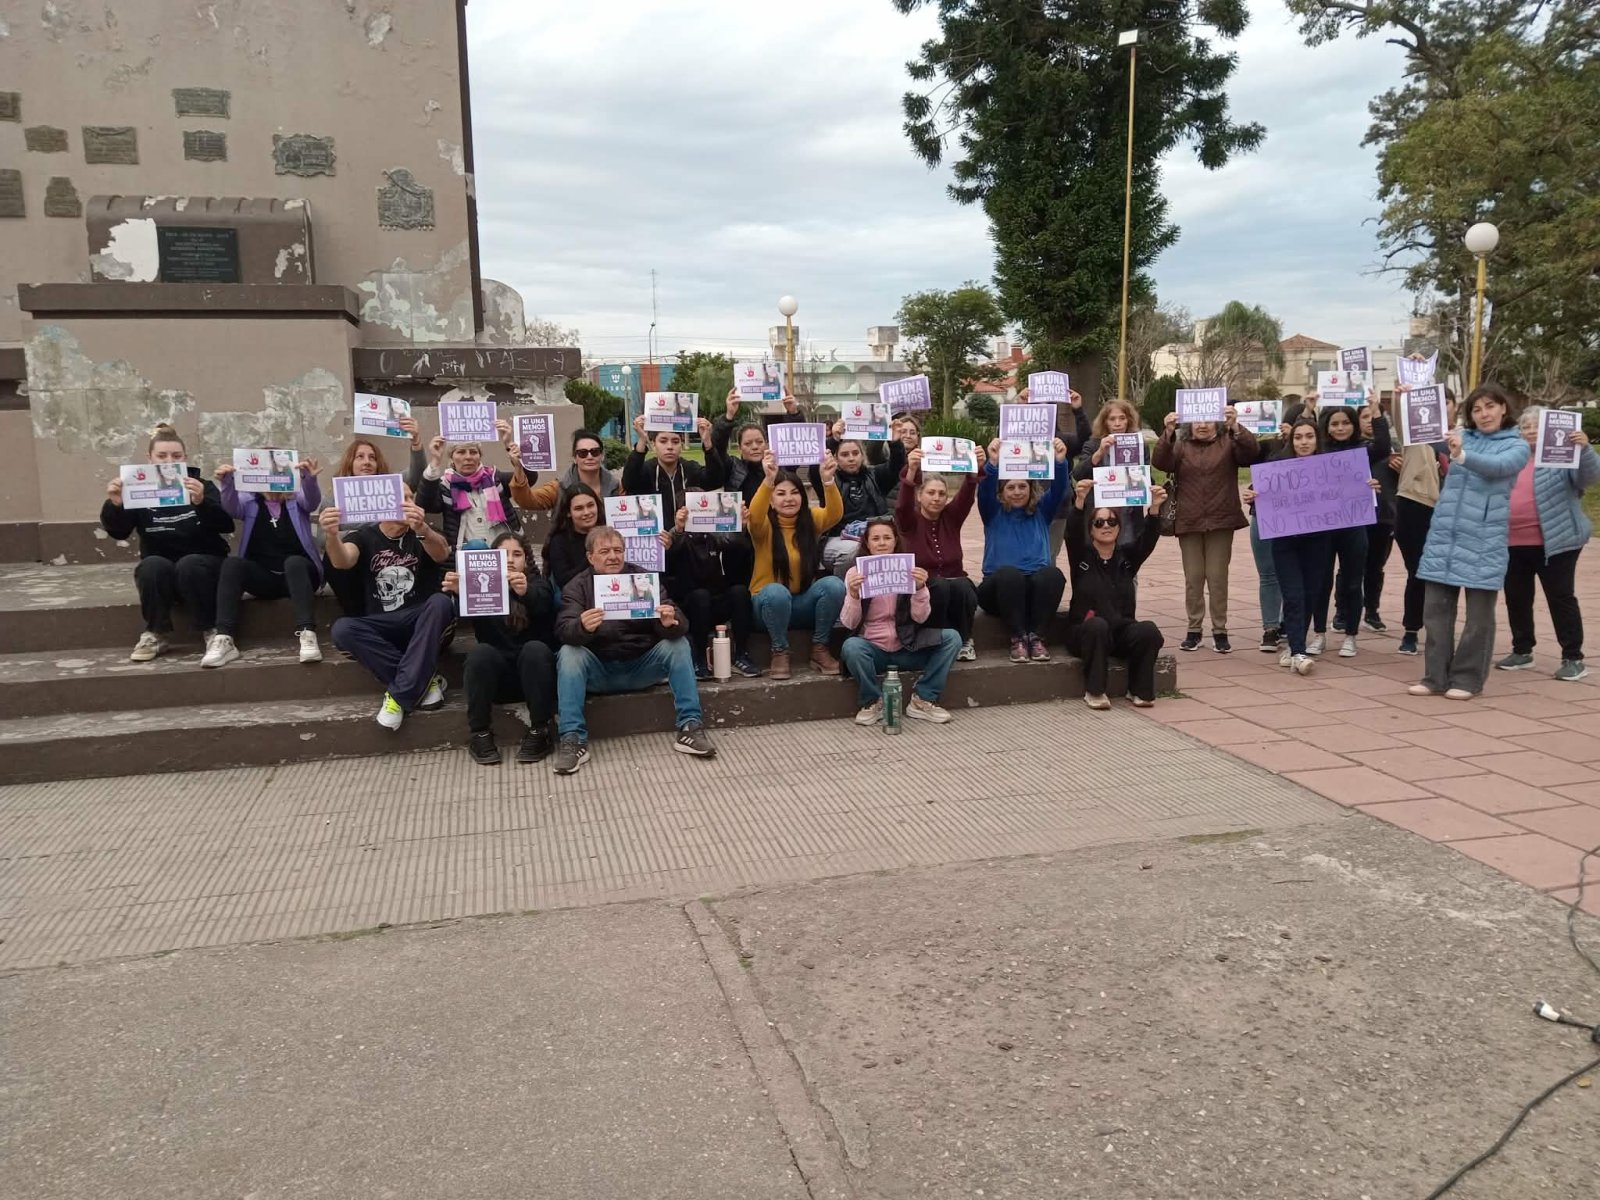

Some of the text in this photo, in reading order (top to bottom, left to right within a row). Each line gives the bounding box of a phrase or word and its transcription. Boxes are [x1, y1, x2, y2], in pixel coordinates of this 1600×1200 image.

[1035, 374, 1065, 384] NI UNA
[888, 380, 922, 396] NI UNA
[1034, 384, 1066, 394] MENOS
[889, 393, 924, 404] MENOS
[1184, 392, 1220, 404] NI UNA
[447, 405, 489, 418] NI UNA
[1008, 408, 1048, 422] NI UNA
[1184, 403, 1220, 414] MENOS
[448, 419, 491, 432] MENOS
[1008, 422, 1048, 434] MENOS
[778, 427, 818, 441] NI UNA
[778, 441, 820, 455] MENOS
[344, 479, 395, 496] NI UNA
[1259, 468, 1310, 494] SOMOS
[345, 495, 396, 512] MENOS
[347, 514, 376, 522] MONTE
[1260, 513, 1286, 533] NO
[632, 536, 657, 548] UNA
[868, 558, 908, 574] NI UNA
[868, 572, 908, 586] MENOS
